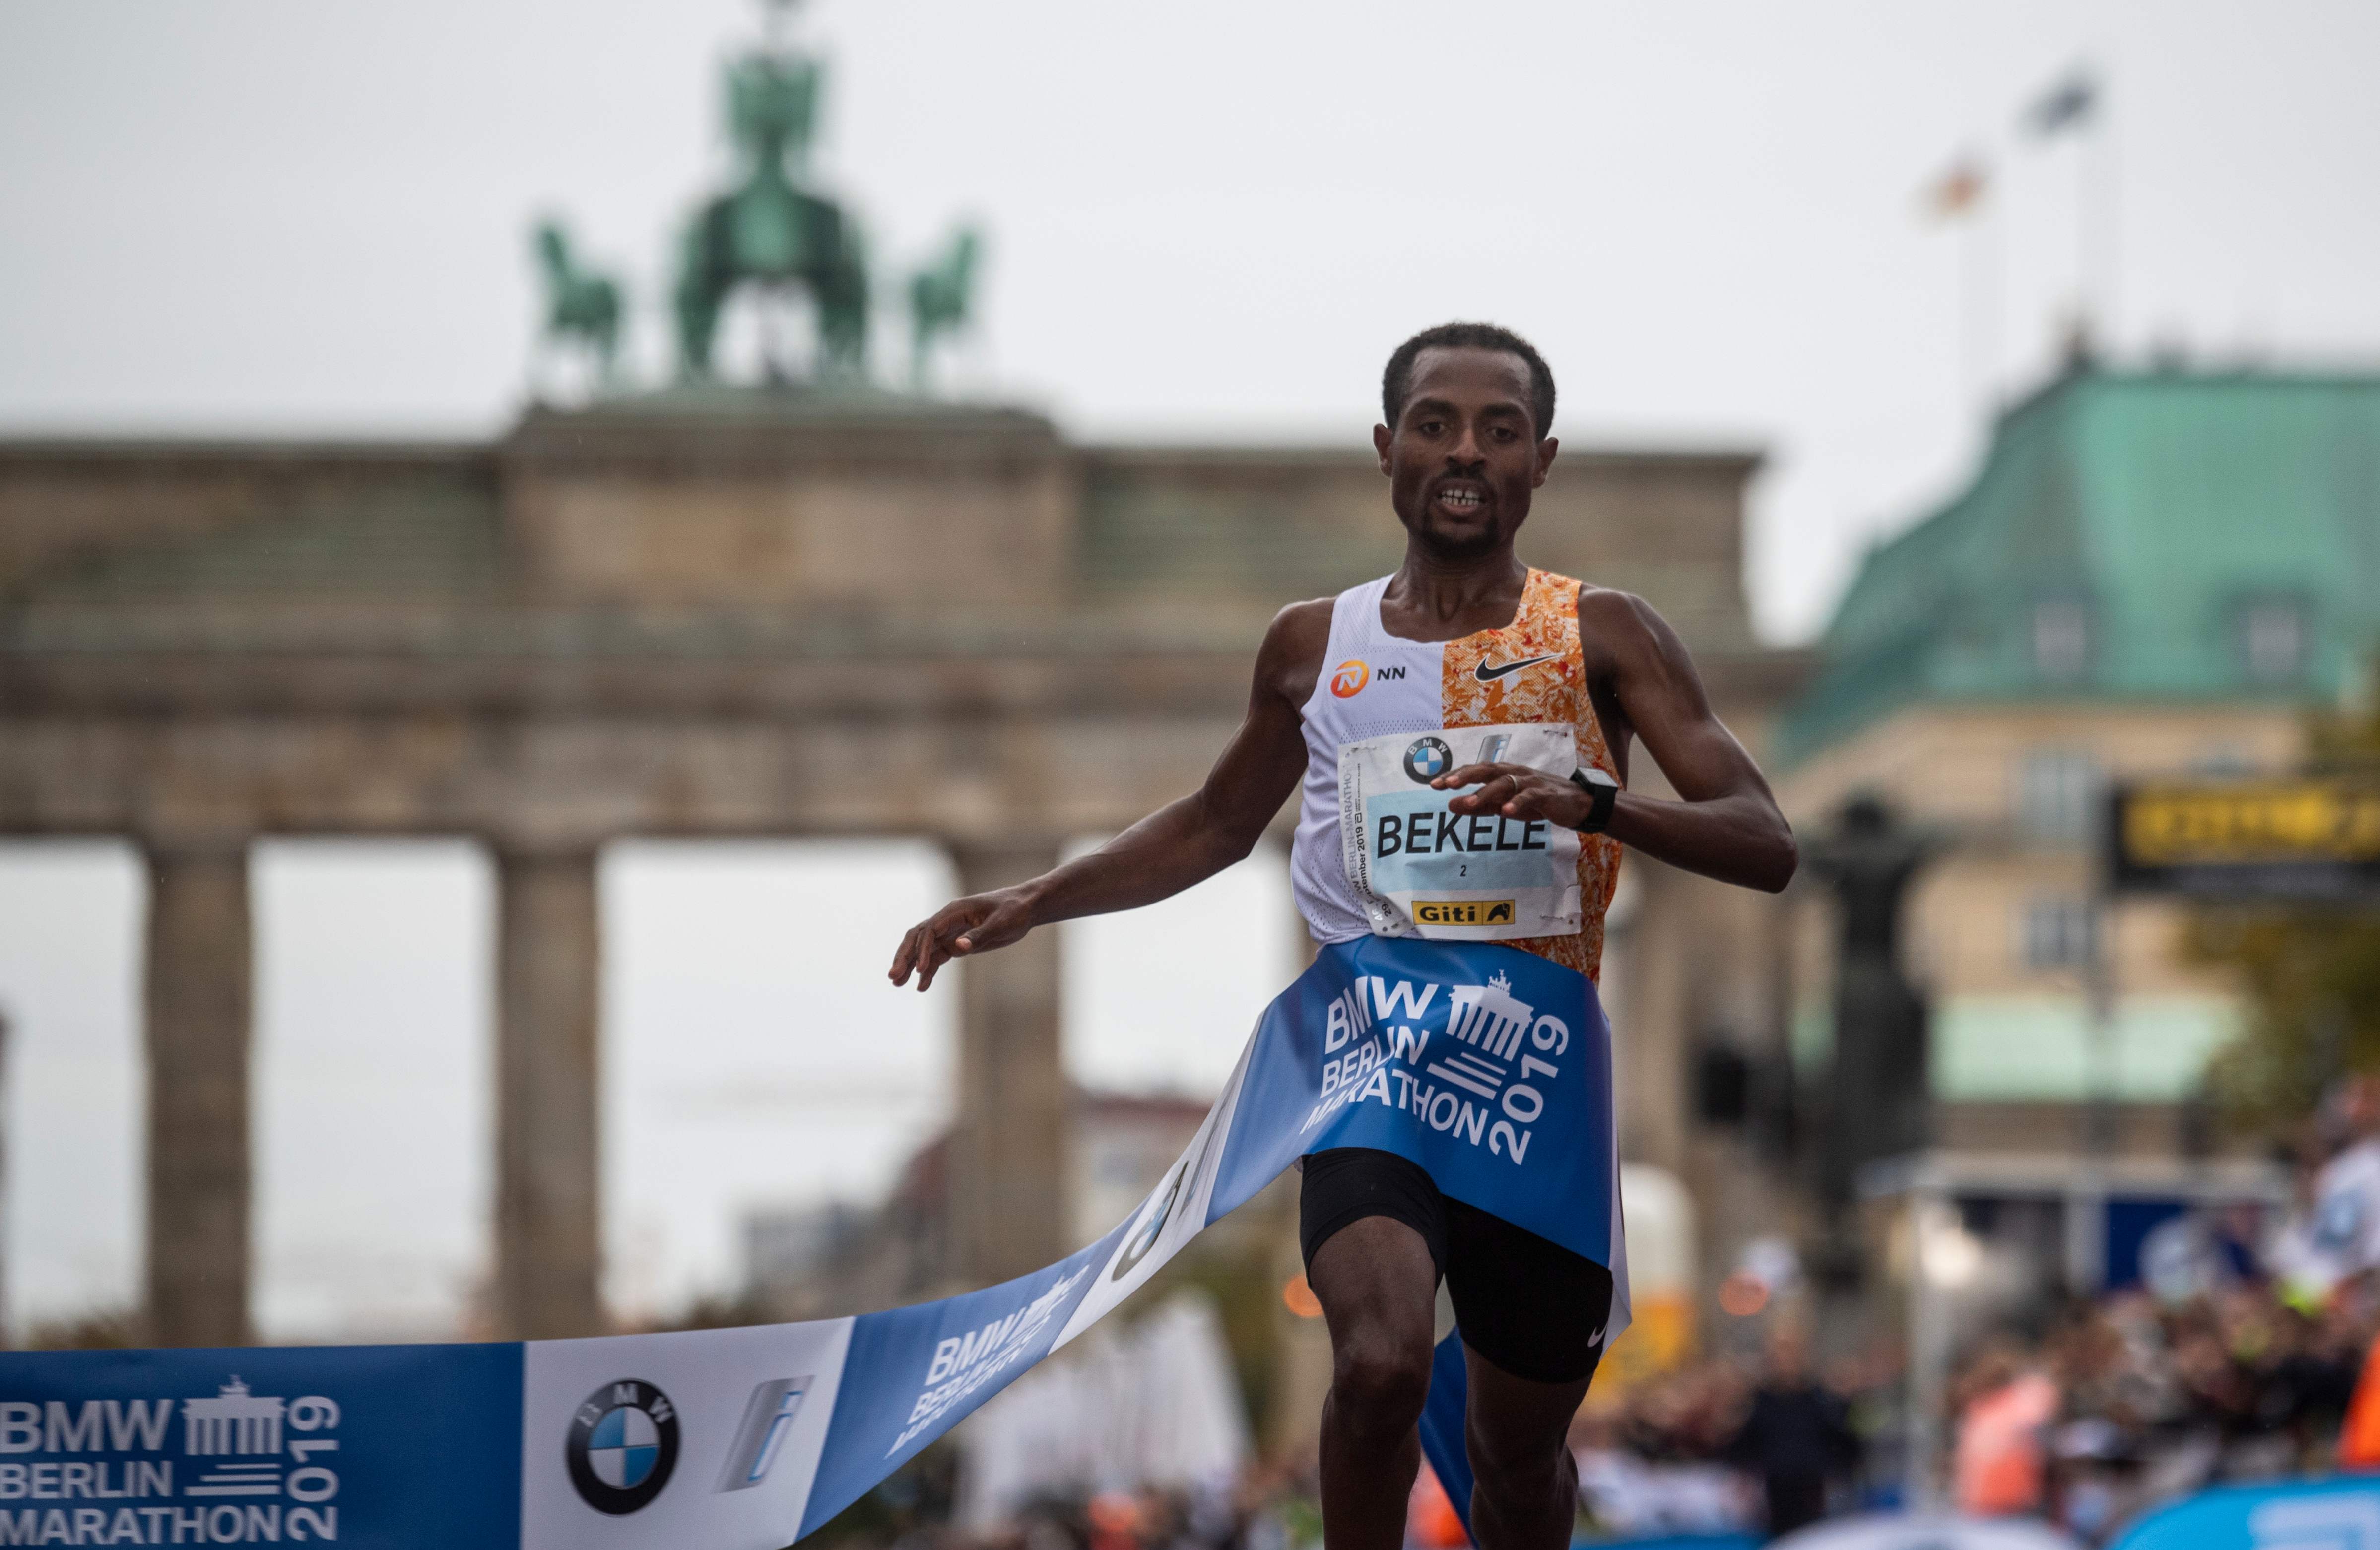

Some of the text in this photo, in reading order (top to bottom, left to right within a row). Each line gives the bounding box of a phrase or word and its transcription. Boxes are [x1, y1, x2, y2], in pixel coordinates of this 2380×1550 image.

[1377, 666, 1405, 681] NN
[1408, 739, 1448, 755] BMW
[1342, 767, 1359, 879] BERLIN-MARATHO
[1355, 826, 1365, 852] 2019
[1377, 811, 1546, 859] BEKELE
[1460, 865, 1467, 877] 2
[1420, 906, 1476, 922] Giti
[1325, 976, 1438, 1054] BMW
[1320, 1026, 1430, 1099] BERLIN
[1299, 1068, 1488, 1146] MARATHON
[1489, 1014, 1569, 1165] 2019
[925, 1307, 1026, 1386] BMW
[0, 1399, 174, 1454] BMW
[0, 1461, 173, 1499] BERLIN
[285, 1395, 340, 1541] 2019
[0, 1505, 281, 1546] MARATHON
